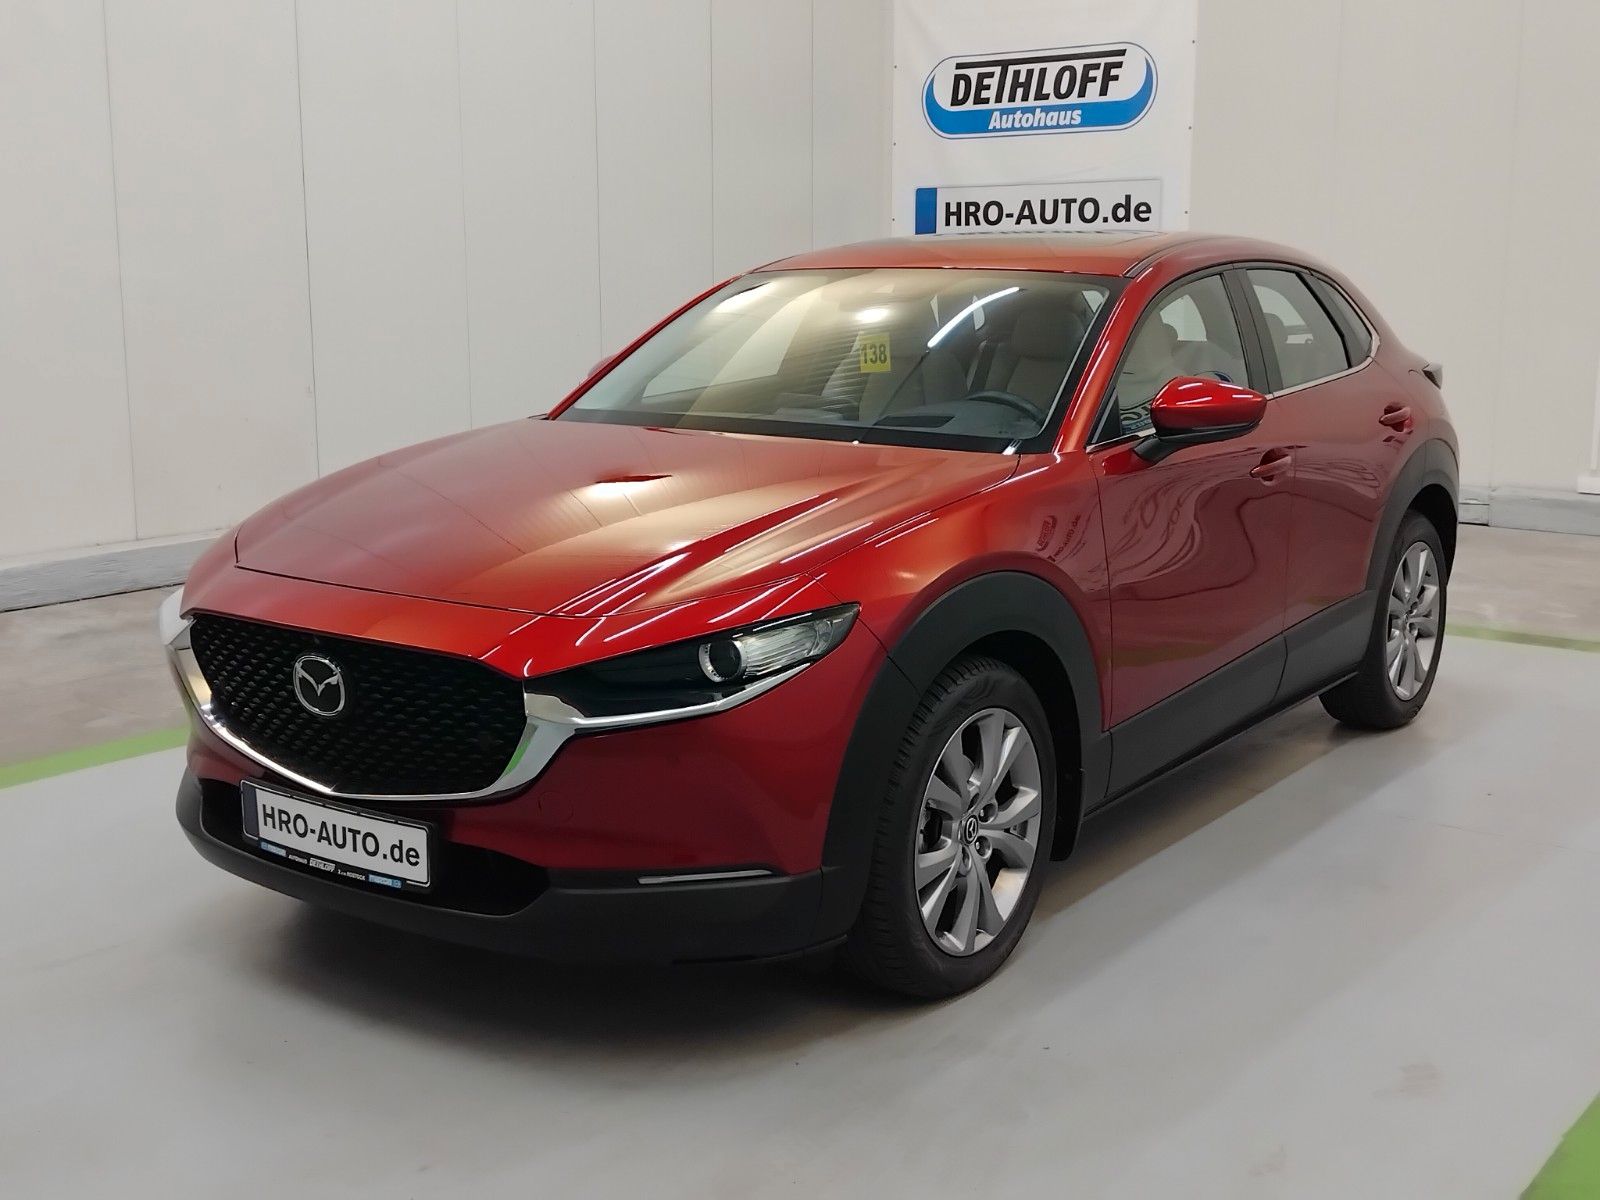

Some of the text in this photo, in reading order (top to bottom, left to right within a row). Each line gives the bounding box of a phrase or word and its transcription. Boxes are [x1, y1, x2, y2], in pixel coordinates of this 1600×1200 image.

[949, 49, 1127, 106] DETHLOFF
[988, 108, 1082, 130] Autohaus
[944, 194, 1152, 227] HRO-AUTO.de
[860, 343, 888, 365] 138
[262, 804, 420, 867] HRO-AUTO.de
